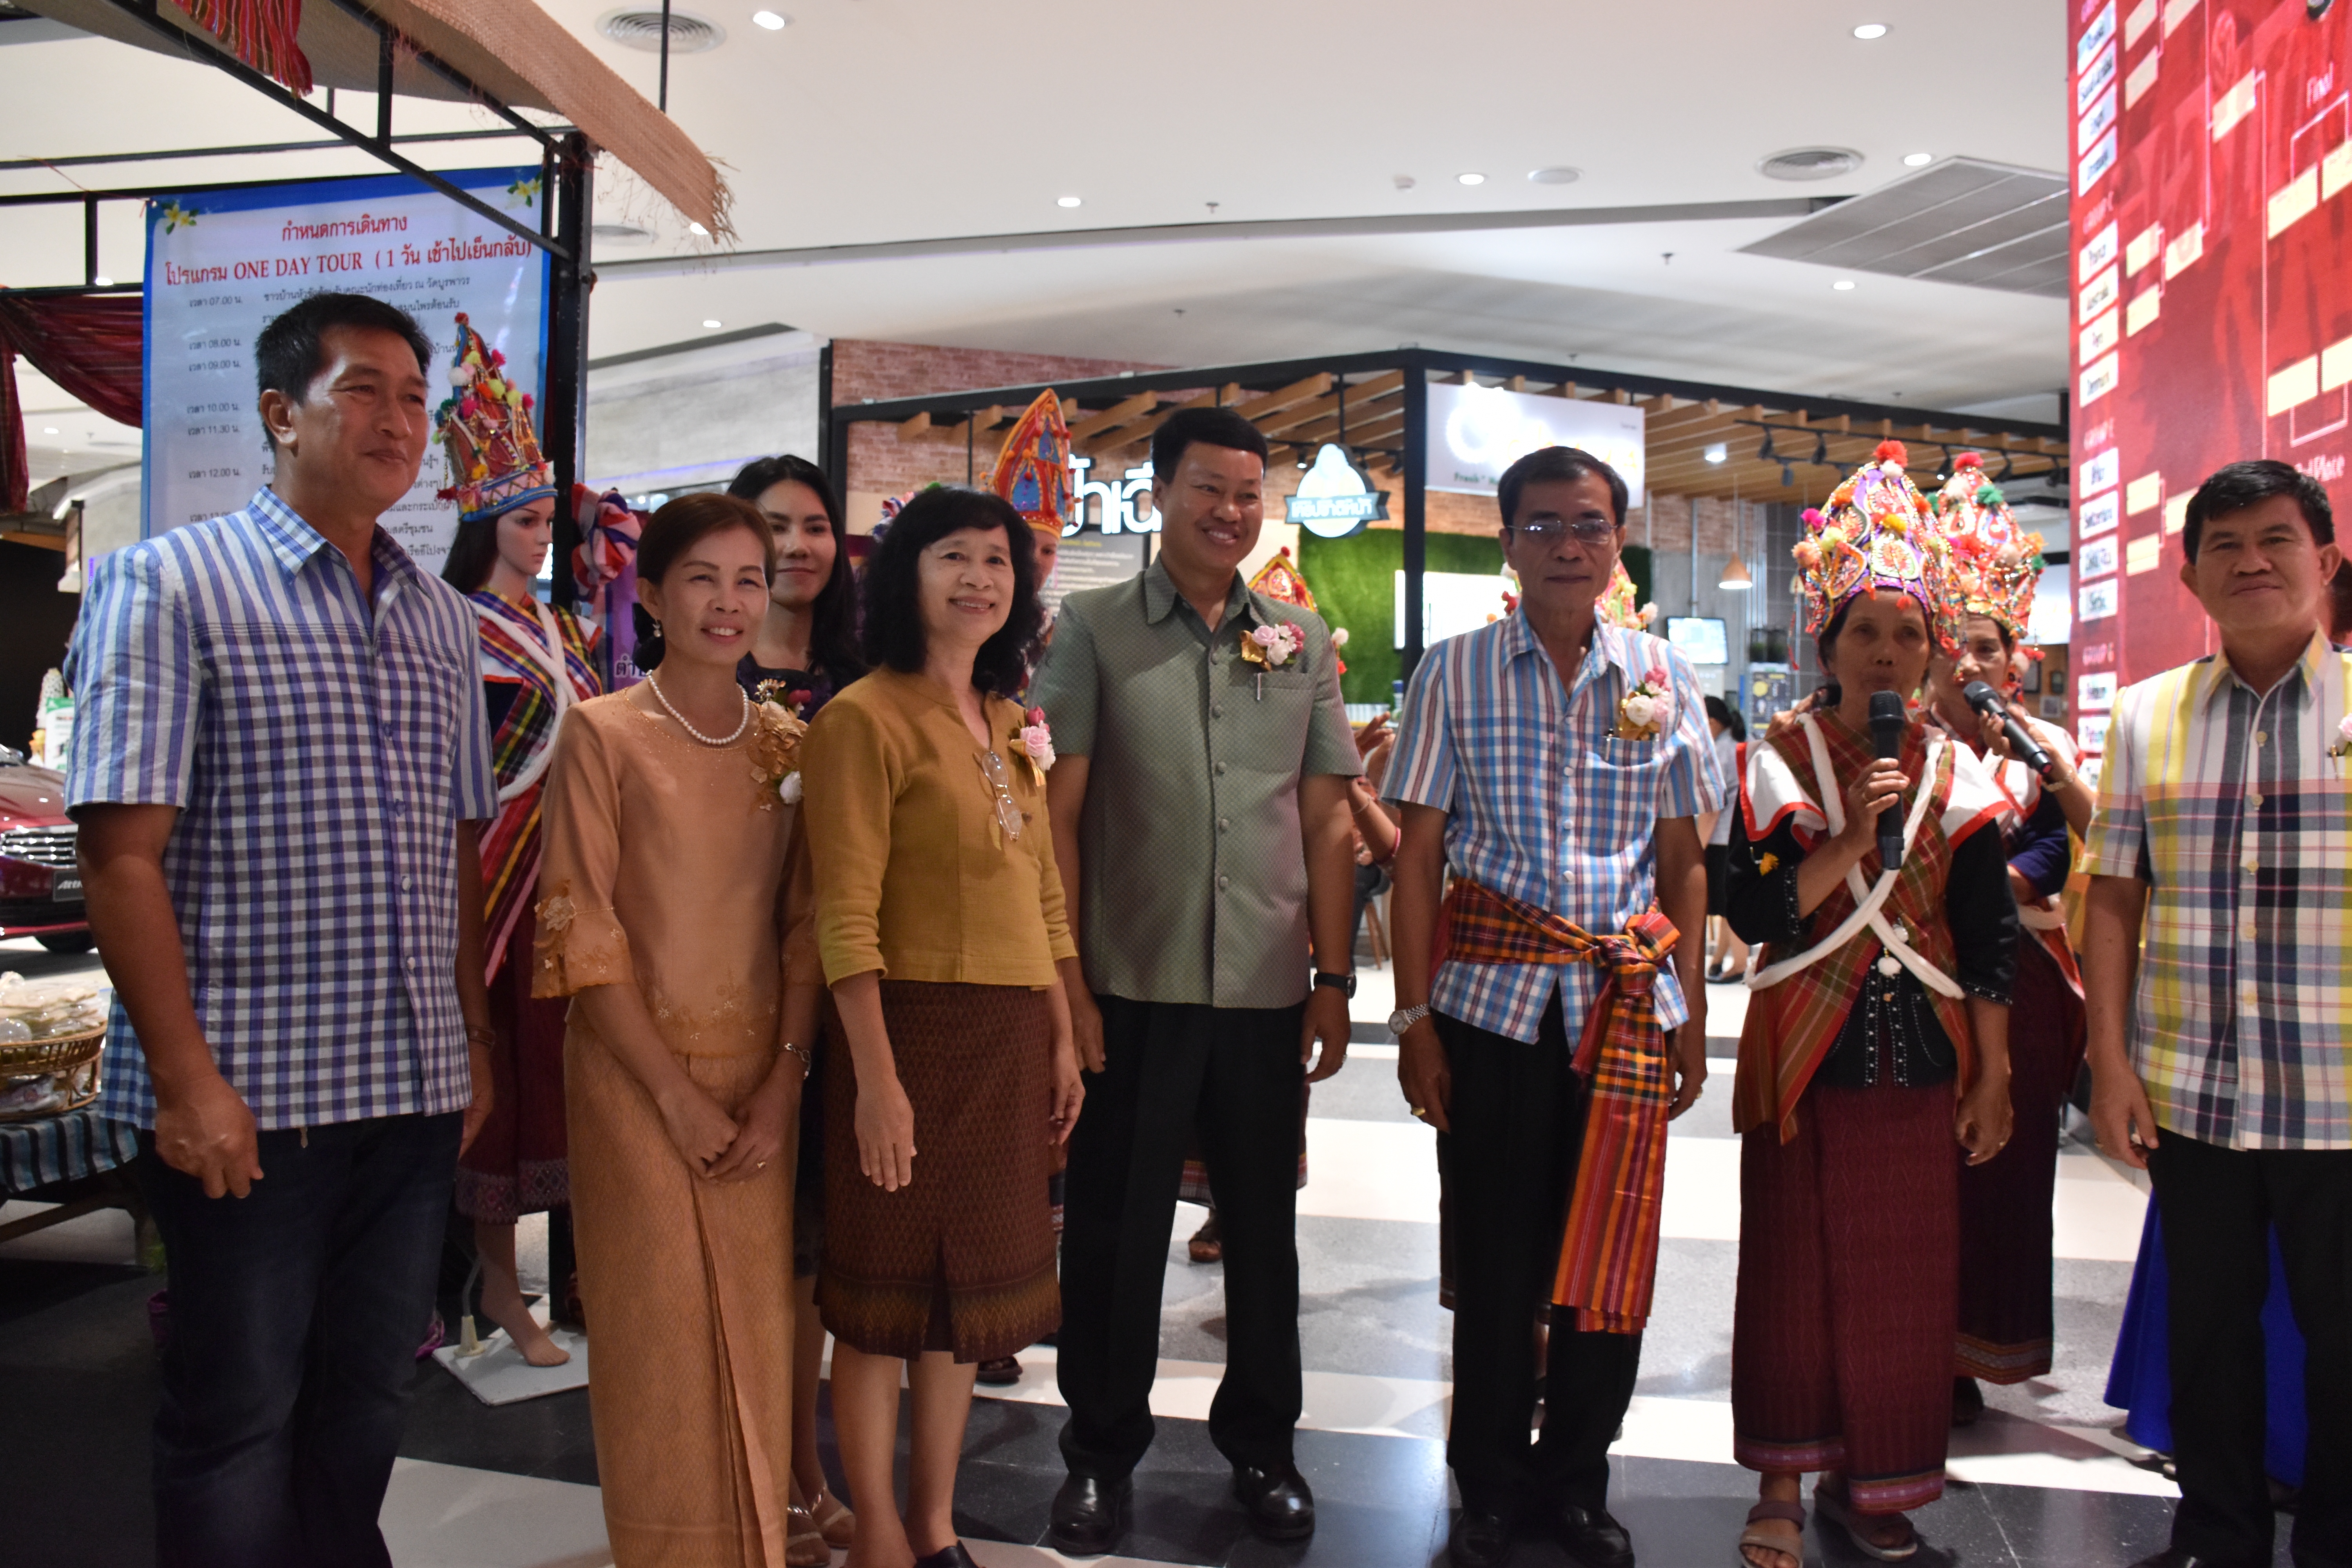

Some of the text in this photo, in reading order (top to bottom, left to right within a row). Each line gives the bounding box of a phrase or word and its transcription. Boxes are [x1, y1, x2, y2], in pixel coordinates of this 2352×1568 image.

[282, 214, 407, 241] กำหนดการเดินทาง
[165, 261, 227, 285] โปรแกรม
[234, 260, 269, 279] ONE
[276, 256, 310, 277] DAY
[317, 252, 363, 273] TOUR
[401, 243, 421, 265] วัน
[209, 295, 233, 306] 07.00
[207, 402, 230, 412] 10.00
[209, 467, 231, 477] 12.00
